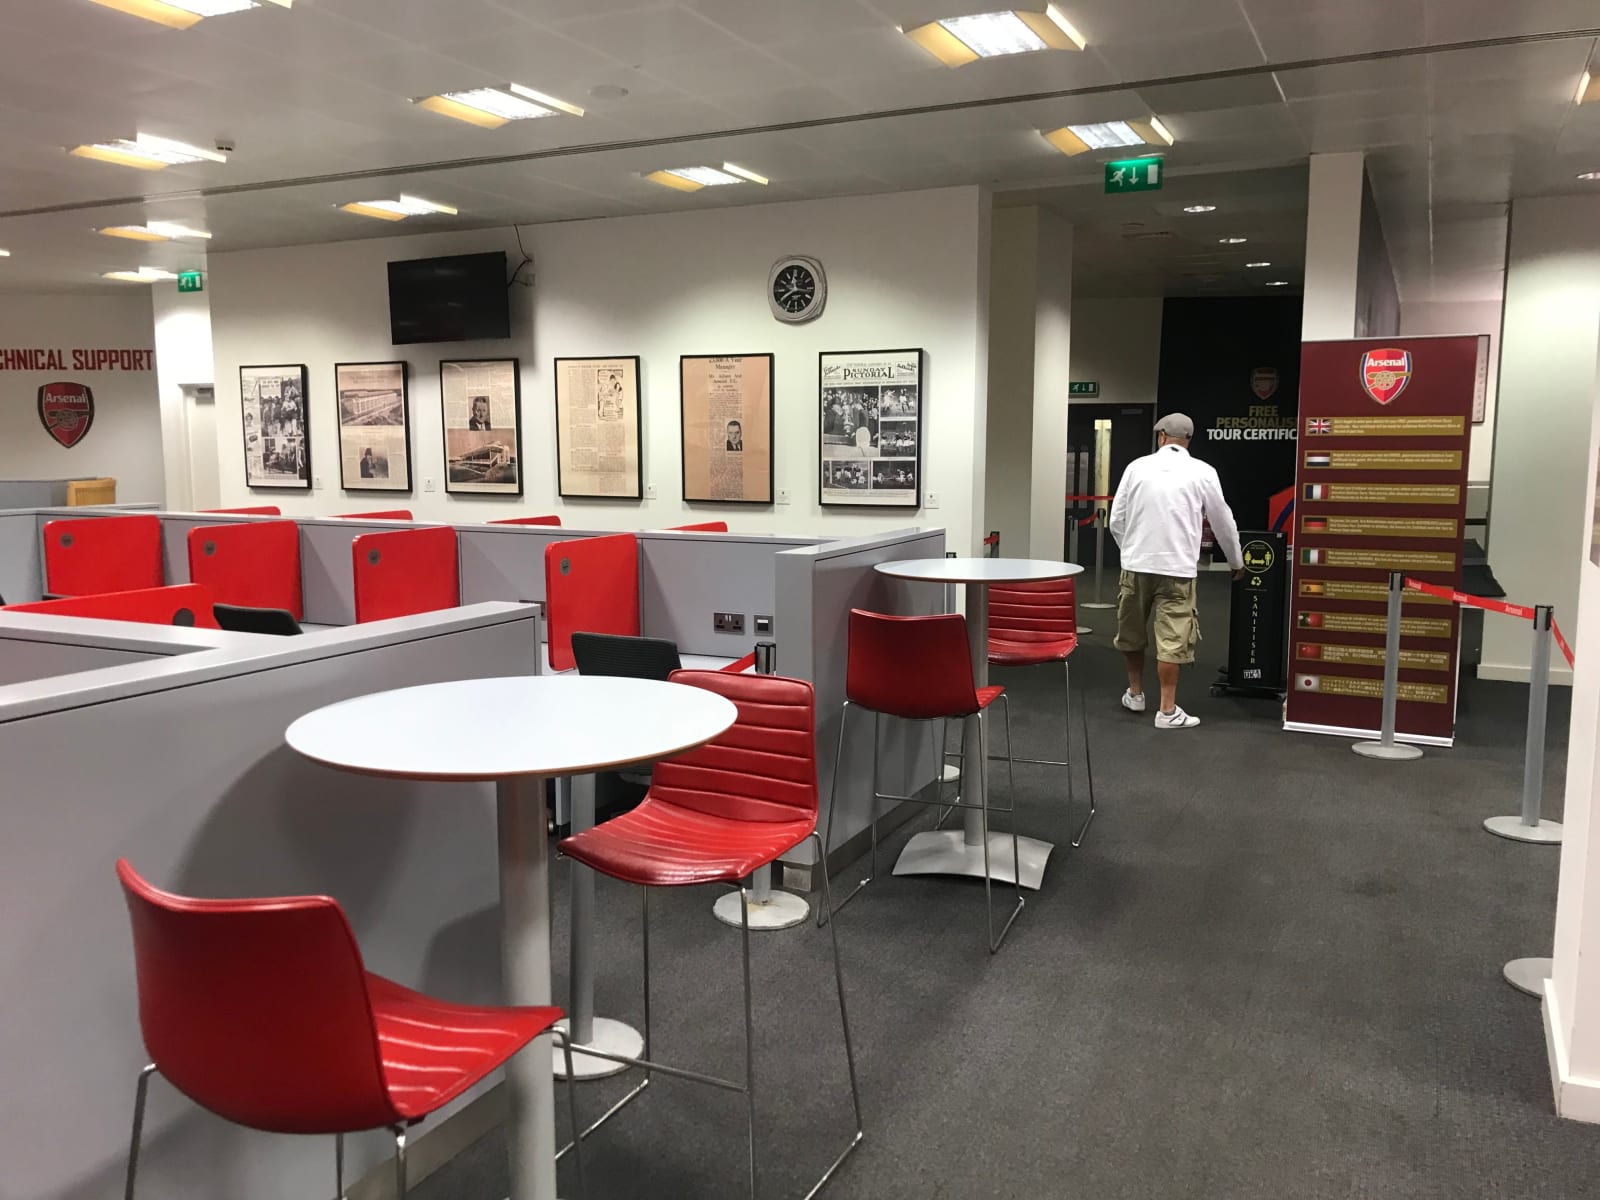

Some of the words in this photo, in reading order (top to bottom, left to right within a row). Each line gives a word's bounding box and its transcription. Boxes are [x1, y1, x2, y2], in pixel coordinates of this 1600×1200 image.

[0, 349, 67, 370] HNICAL
[73, 349, 153, 370] SUPPORT
[1367, 357, 1405, 368] Arsenal
[843, 366, 895, 380] PICTORIAL
[46, 392, 87, 404] Arsenal
[1249, 405, 1279, 417] FREE
[1216, 417, 1298, 429] PERSONALIS
[1207, 429, 1242, 441] TOUR
[1243, 429, 1298, 441] CERTIFIC
[1250, 594, 1258, 665] SANITISER
